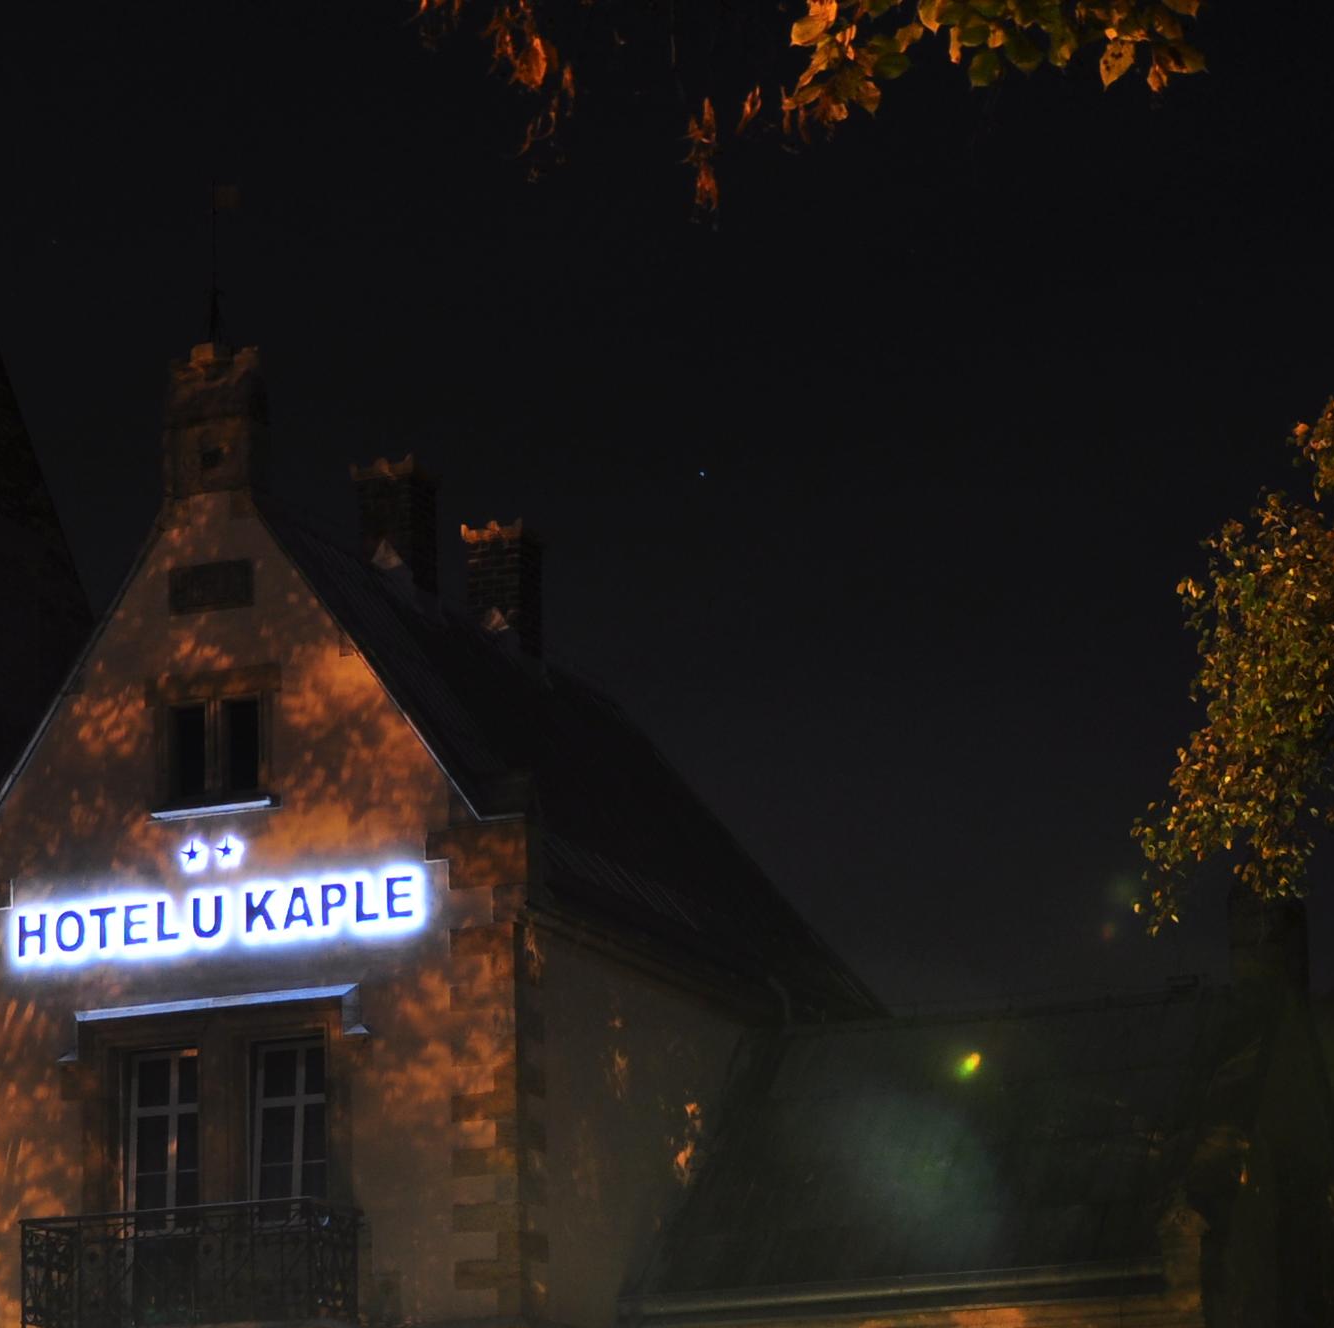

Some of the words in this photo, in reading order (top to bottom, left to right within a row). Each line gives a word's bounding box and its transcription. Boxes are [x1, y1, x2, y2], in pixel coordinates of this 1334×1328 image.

[18, 900, 179, 958] HOTEL
[192, 895, 223, 938] U
[245, 875, 413, 933] KAPLE
